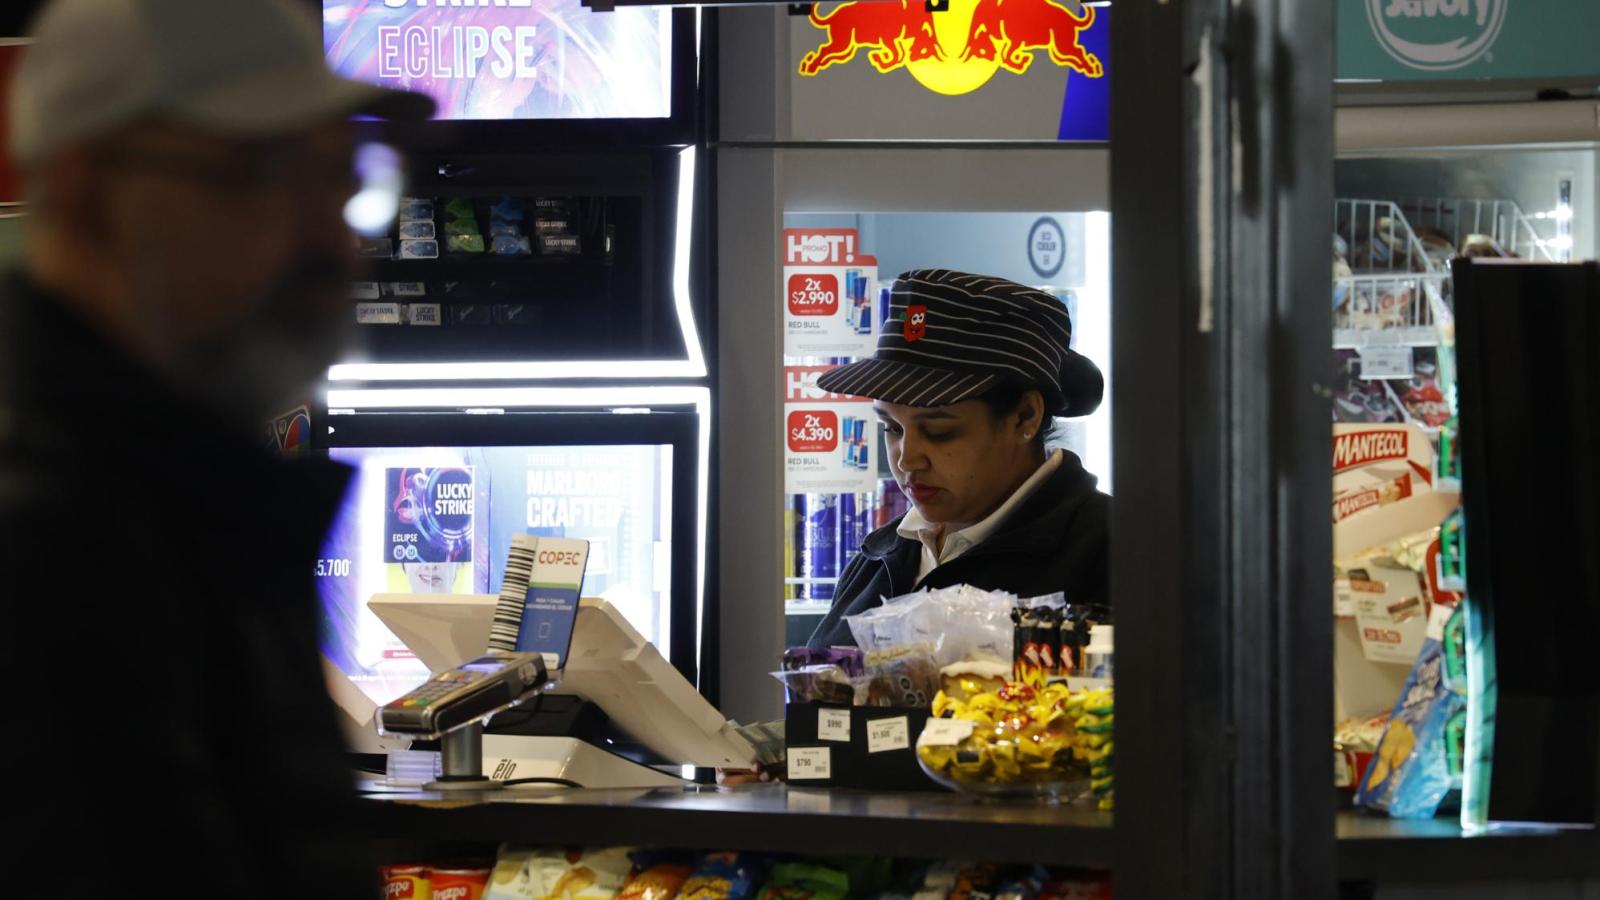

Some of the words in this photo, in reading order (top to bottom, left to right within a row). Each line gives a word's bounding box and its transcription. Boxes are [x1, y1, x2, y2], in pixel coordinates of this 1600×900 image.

[378, 26, 537, 79] ECLIPSE
[788, 235, 854, 263] HOT!
[805, 278, 820, 291] 2x
[792, 291, 834, 305] $2.990
[416, 306, 435, 314] LUCKY
[788, 371, 853, 399] HO
[804, 414, 820, 427] 2x
[792, 427, 833, 441] $4.390
[1334, 433, 1405, 465] MANTECOL
[437, 483, 473, 499] LUCKY
[435, 499, 473, 516] STRIKE
[527, 496, 622, 527] CRAFTED
[393, 533, 418, 543] ECLIPSE
[538, 549, 581, 566] COPEC
